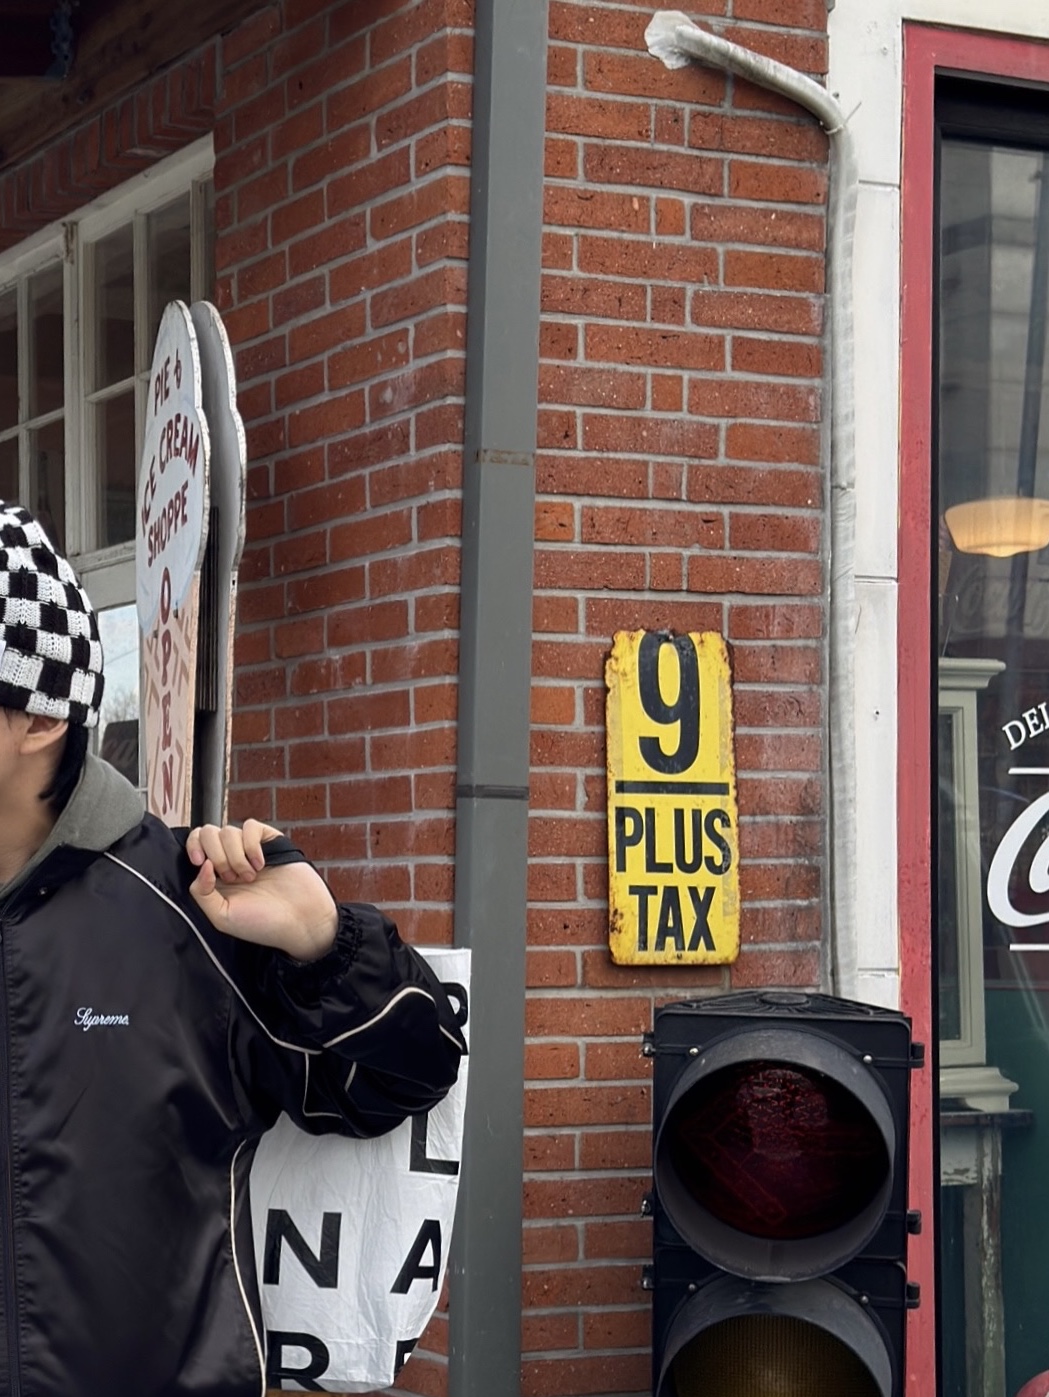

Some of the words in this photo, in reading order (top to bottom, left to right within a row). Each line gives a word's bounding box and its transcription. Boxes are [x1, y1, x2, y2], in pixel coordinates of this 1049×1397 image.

[154, 356, 171, 417] PIE
[141, 456, 158, 538] ICE
[159, 412, 200, 478] CREAM
[147, 479, 189, 568] SHOPPE
[158, 566, 174, 815] OPEN
[637, 631, 701, 775] 9
[614, 806, 731, 875] PLUS
[628, 886, 717, 952] TAX
[74, 1006, 130, 1031] Supreme
